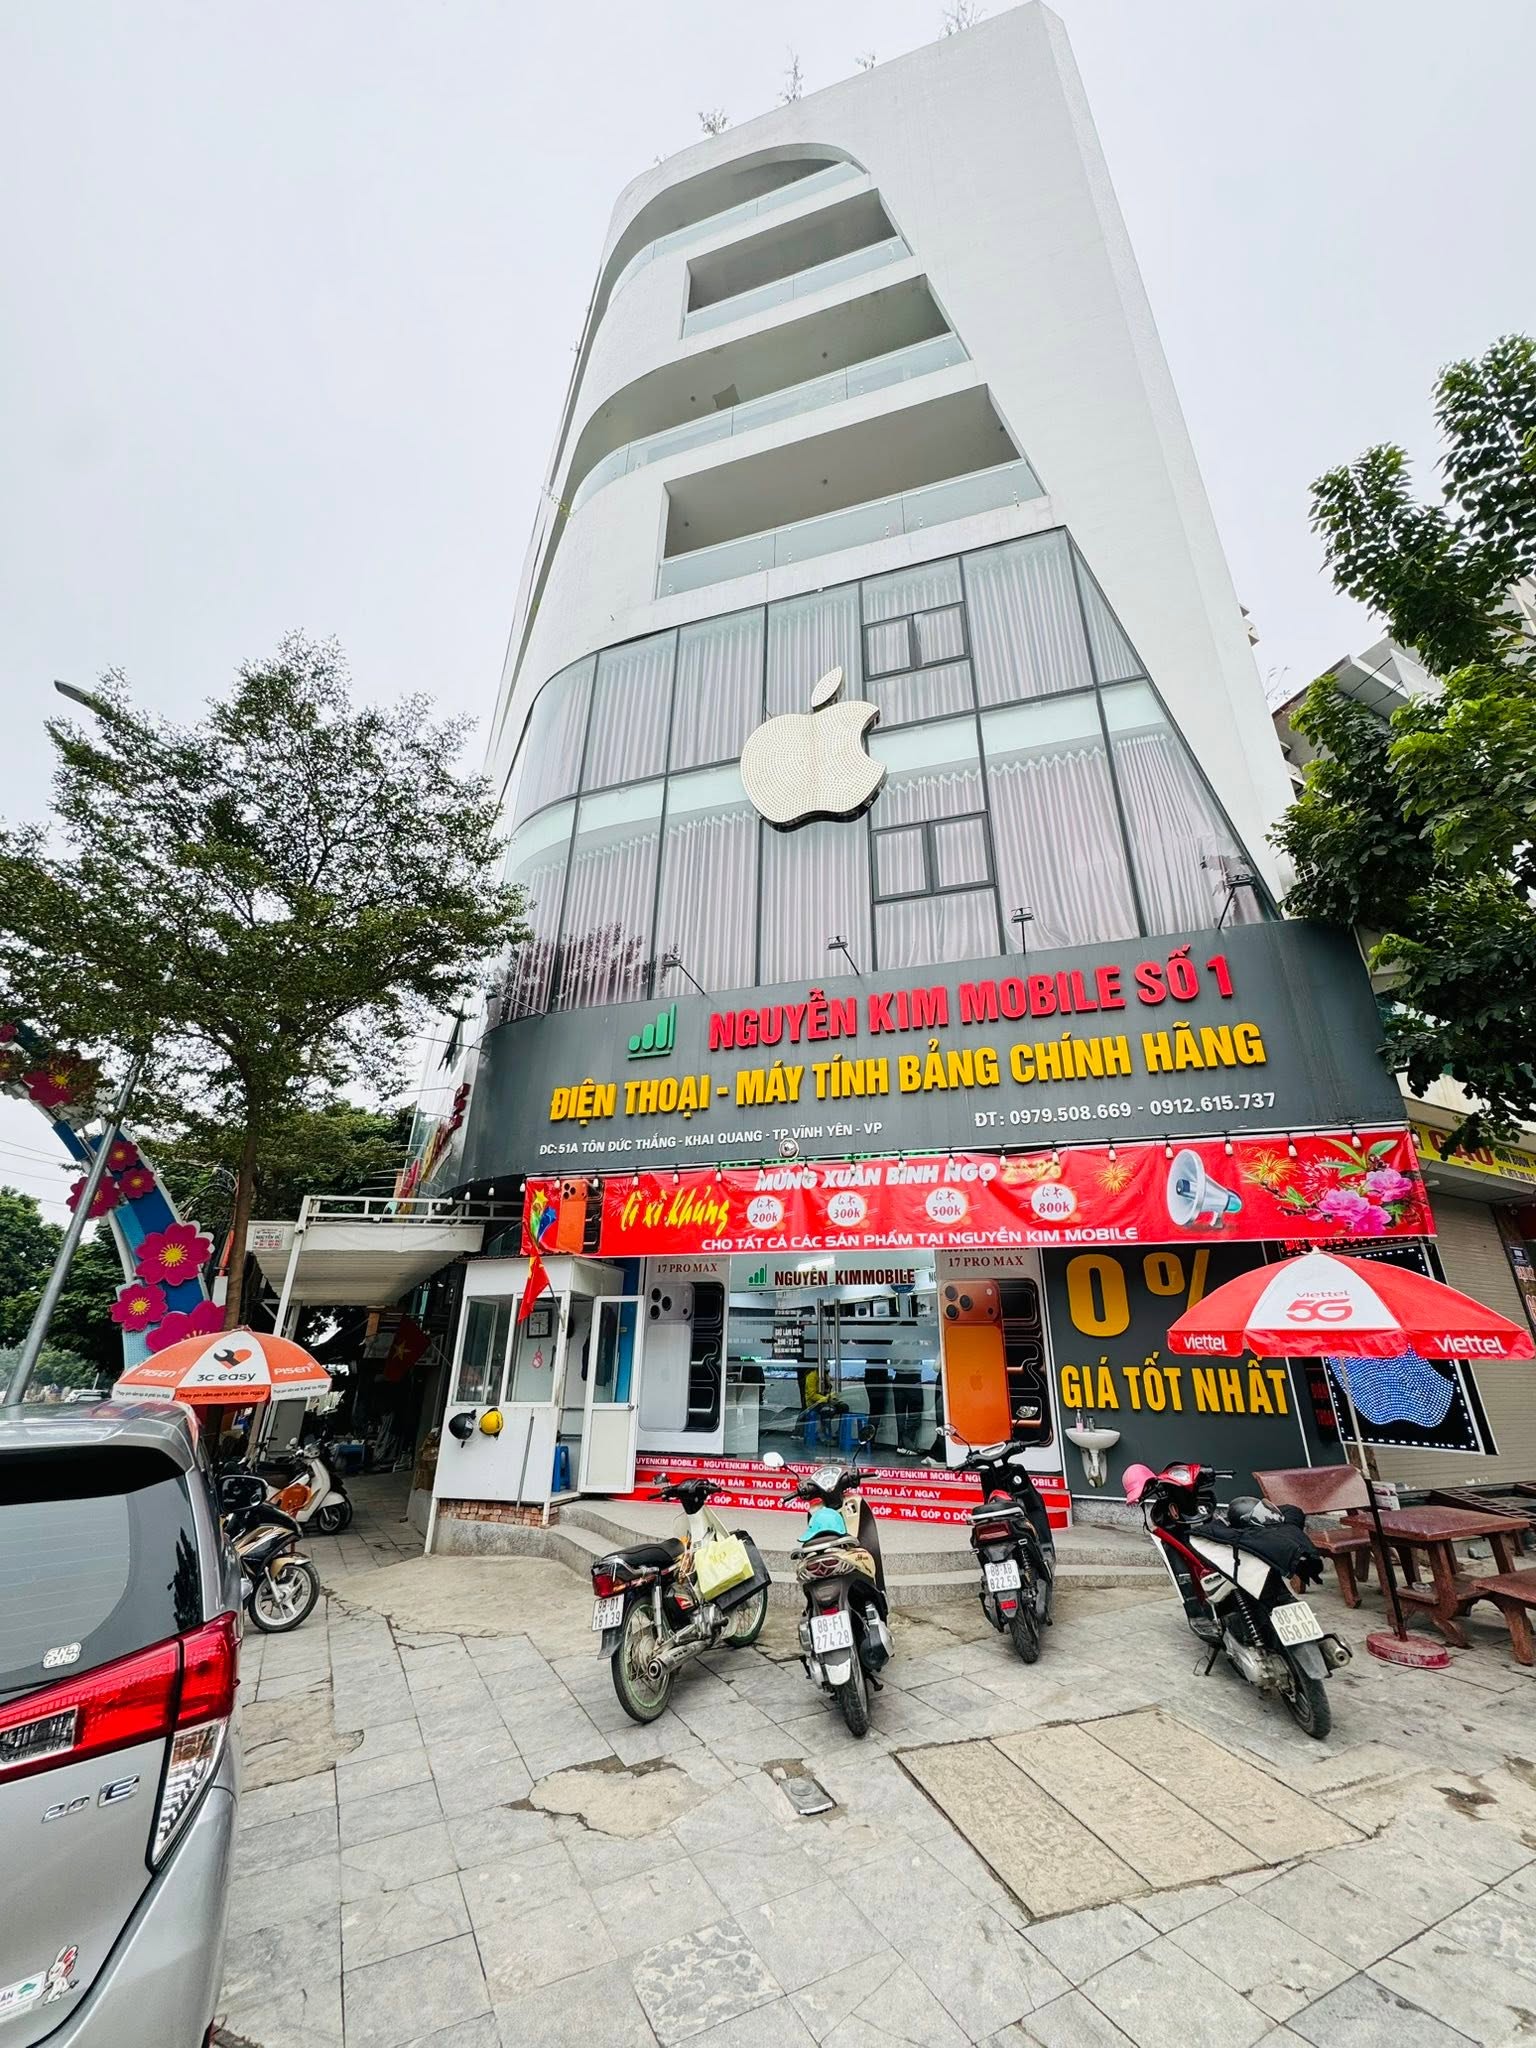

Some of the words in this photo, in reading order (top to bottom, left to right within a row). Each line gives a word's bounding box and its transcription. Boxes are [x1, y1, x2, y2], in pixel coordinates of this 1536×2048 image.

[708, 987, 857, 1051] NGUYỄN
[869, 986, 949, 1034] KIM
[959, 965, 1126, 1026] MOBILE
[1134, 944, 1199, 1006] SỐ
[1206, 954, 1233, 998] 1
[549, 1077, 616, 1127] ĐIỆN
[624, 1073, 710, 1119] THOẠI
[716, 1086, 730, 1096] -
[736, 1060, 804, 1106] MÁY
[812, 1054, 889, 1100] TÍNH
[899, 1039, 1000, 1093] BẢNG
[1009, 1032, 1131, 1084] CHÍNH
[1142, 1021, 1267, 1074] HÃNG
[1009, 1102, 1131, 1125] 0979.508.669
[1149, 1092, 1276, 1117] 0912.615.737
[558, 1143, 579, 1154] 51A
[581, 1140, 605, 1153] TÔN
[608, 1138, 632, 1152] ĐỨC
[635, 1133, 676, 1150] THẮNG
[685, 1134, 714, 1146] KHAI
[717, 1130, 762, 1144] QUANG
[773, 1129, 789, 1140] TP
[792, 1125, 823, 1139] VĨNH
[827, 1122, 853, 1136] YÊN
[864, 1122, 882, 1134] VP
[823, 1165, 881, 1188] XUÂN
[944, 1162, 997, 1187] NGỌ
[833, 1207, 860, 1219] 300k
[932, 1205, 961, 1217] 500k
[1039, 1202, 1071, 1214] 800k
[752, 1212, 778, 1223] 200k
[701, 1238, 733, 1250] CHO
[736, 1234, 764, 1249] TẤT
[767, 1233, 788, 1248] CẢ
[790, 1233, 822, 1247] CÁC
[825, 1232, 859, 1246] SẢN
[863, 1230, 913, 1245] PHẨM
[917, 1232, 944, 1248] TẠI
[1026, 1230, 1061, 1242] KIM
[1065, 1227, 1138, 1241] MOBILE
[656, 1264, 668, 1273] 17
[669, 1263, 691, 1272] PRO
[693, 1263, 718, 1272] MAX
[948, 1257, 961, 1267] 17
[963, 1256, 990, 1267] PRO
[993, 1256, 1024, 1266] MAX
[1296, 1290, 1351, 1298] viettel
[1286, 1298, 1353, 1323] 5G
[1184, 1334, 1227, 1351] viettel
[1432, 1334, 1508, 1355] viettel
[197, 1374, 215, 1382] 3C
[217, 1372, 256, 1382] easy
[1060, 1356, 1119, 1409] GIÁ
[1122, 1351, 1183, 1412] TỐT
[1191, 1354, 1288, 1414] NHẤT
[670, 1458, 698, 1467] MOBILE
[728, 1478, 745, 1487] BÁN
[752, 1480, 774, 1489] TRAO
[1031, 1477, 1058, 1488] OBILE
[864, 1486, 892, 1498] THOẠI
[914, 1489, 941, 1499] NGAY
[713, 1492, 732, 1503] GÓP
[738, 1493, 756, 1506] TRẢ
[757, 1497, 775, 1508] GÓP
[872, 1505, 892, 1516] GÓP
[900, 1505, 919, 1517] TRẢ
[920, 1508, 941, 1519] GÓP
[97, 1774, 141, 1809] E
